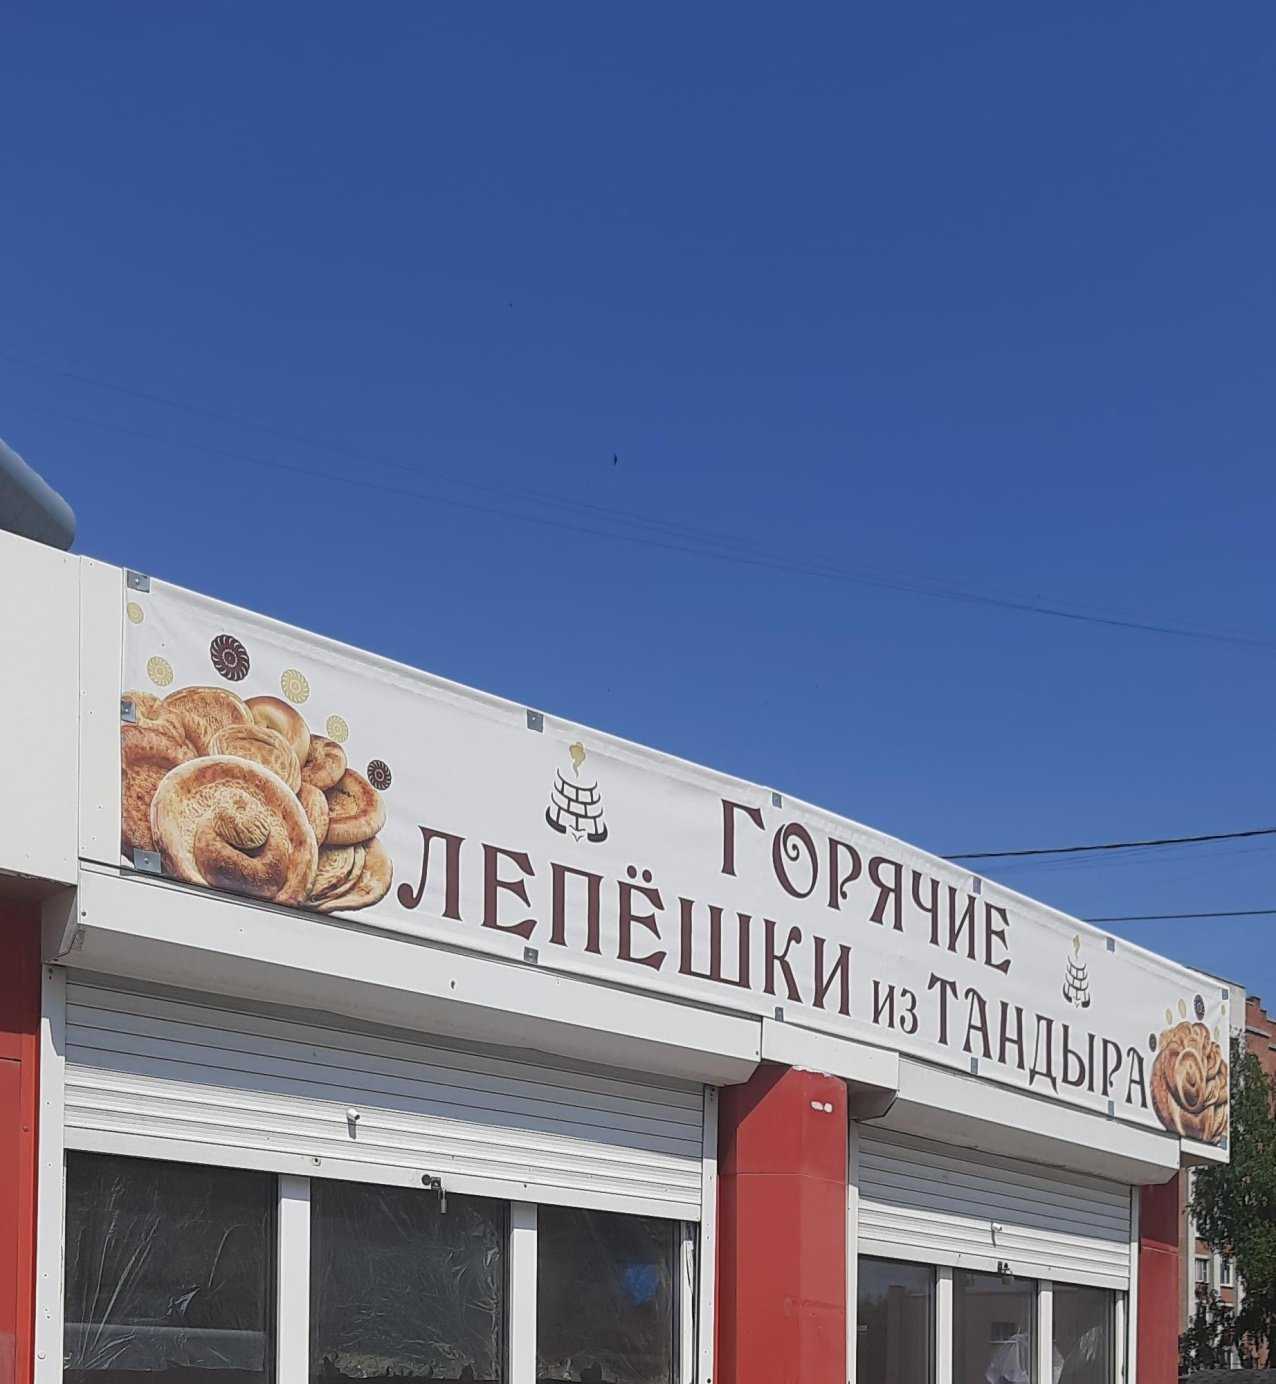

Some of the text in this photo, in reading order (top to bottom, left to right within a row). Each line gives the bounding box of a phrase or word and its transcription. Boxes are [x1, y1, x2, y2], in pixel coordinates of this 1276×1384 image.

[396, 825, 852, 1017] ЛЕПЁШКИ
[927, 970, 1149, 1110] ТАНДЫРА
[721, 798, 1012, 975] ГОРЯЧИЕ
